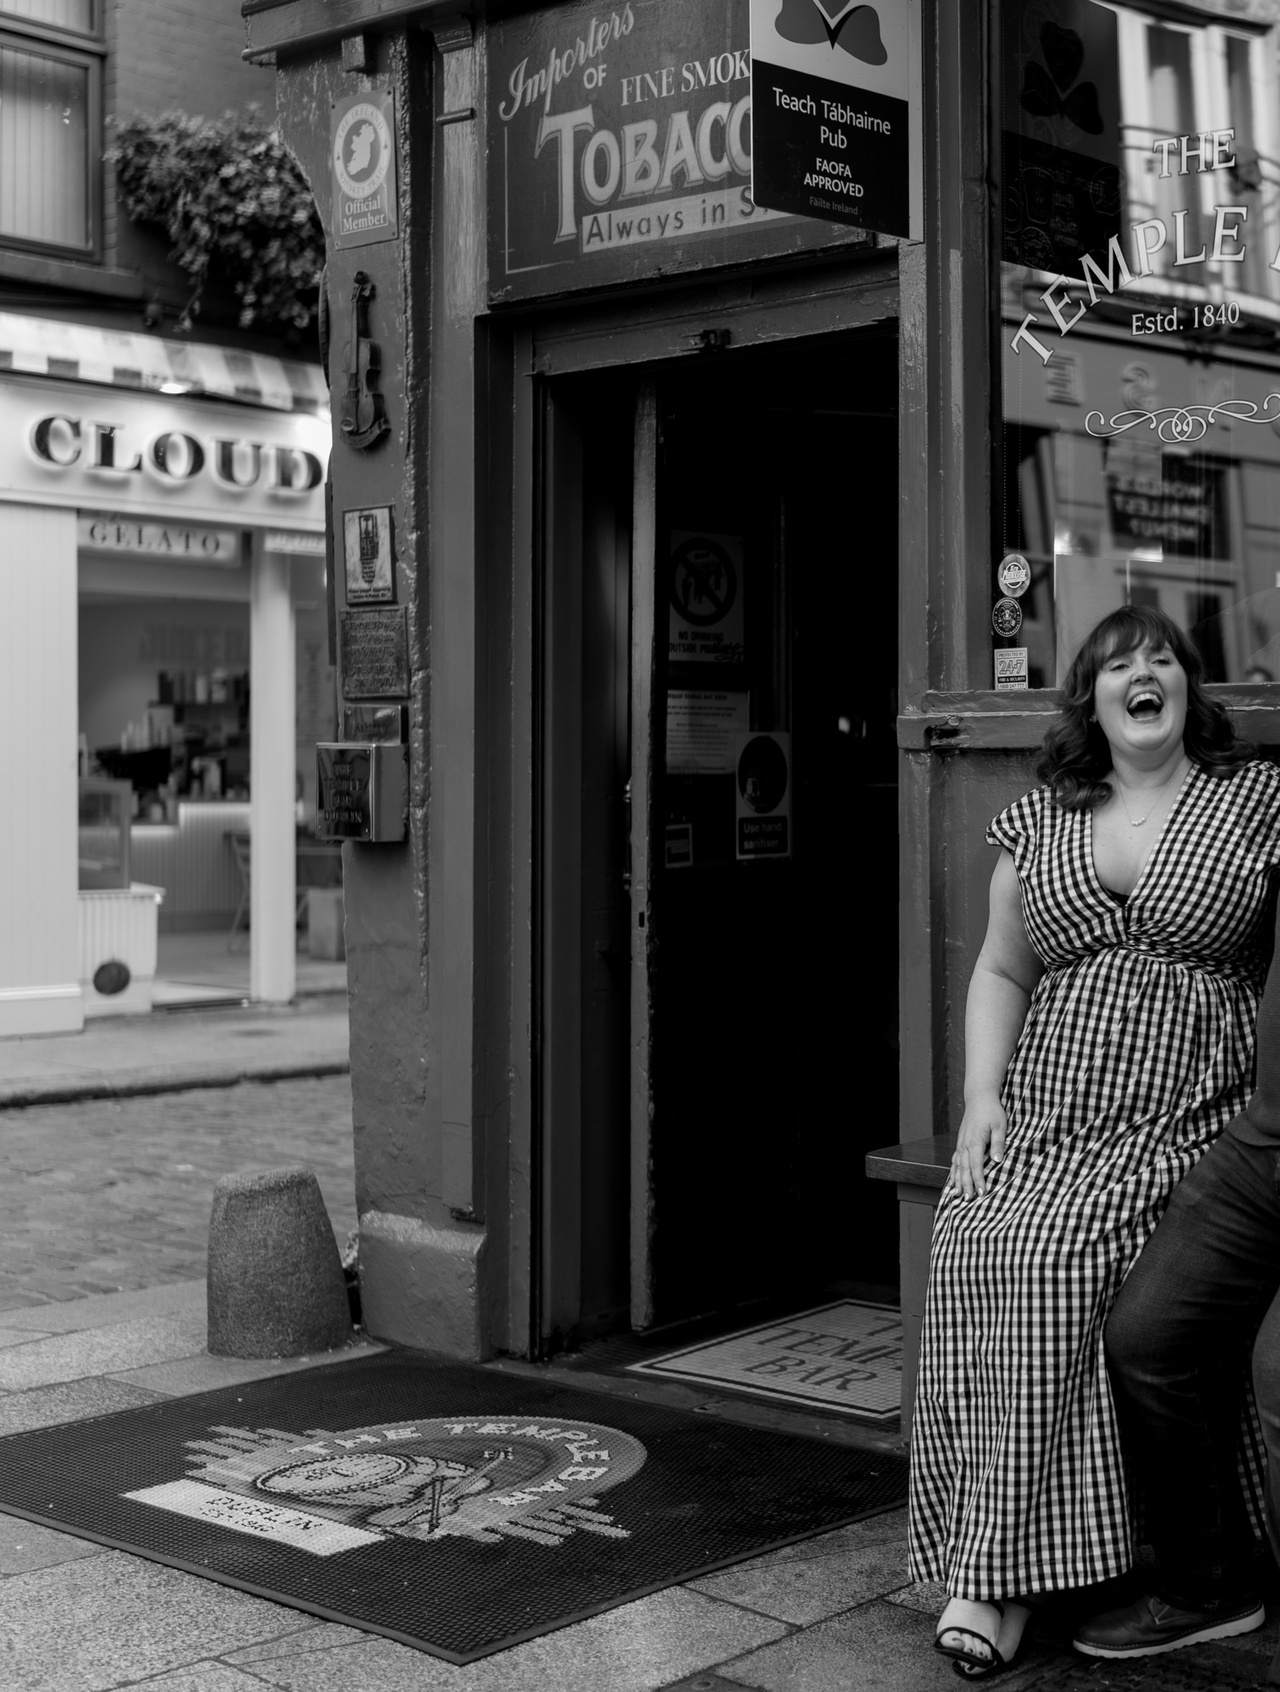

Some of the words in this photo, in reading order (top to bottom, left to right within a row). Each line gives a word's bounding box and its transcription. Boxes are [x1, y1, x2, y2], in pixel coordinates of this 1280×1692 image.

[499, 2, 635, 121] Importers
[583, 63, 607, 89] OF
[620, 67, 675, 107] FINE
[773, 86, 816, 116] Teach
[820, 99, 892, 136] Tábhairne
[820, 125, 848, 150] Pub
[1153, 129, 1236, 179] THE
[815, 157, 852, 179] FAOFA
[803, 174, 864, 198] APPROVED
[343, 212, 385, 232] Member
[345, 195, 381, 216] Official
[586, 206, 684, 245] Always
[701, 198, 725, 225] in
[831, 199, 859, 216] Ireland
[1011, 206, 1248, 366] TEMPLE
[1131, 308, 1184, 336] Estd.
[1192, 301, 1240, 328] 1840
[32, 415, 324, 490] CLOUD
[89, 520, 220, 556] GELATO
[679, 631, 688, 641] NO
[691, 632, 724, 642] DRINKING
[743, 823, 759, 834] Use
[762, 822, 782, 833] hand
[743, 839, 779, 850] sanitiser
[743, 1356, 877, 1390] BAR
[287, 1426, 422, 1456] THE
[443, 1422, 611, 1463] TEMPLE
[489, 1466, 608, 1507] BAR
[206, 1496, 323, 1530] DUBLIN
